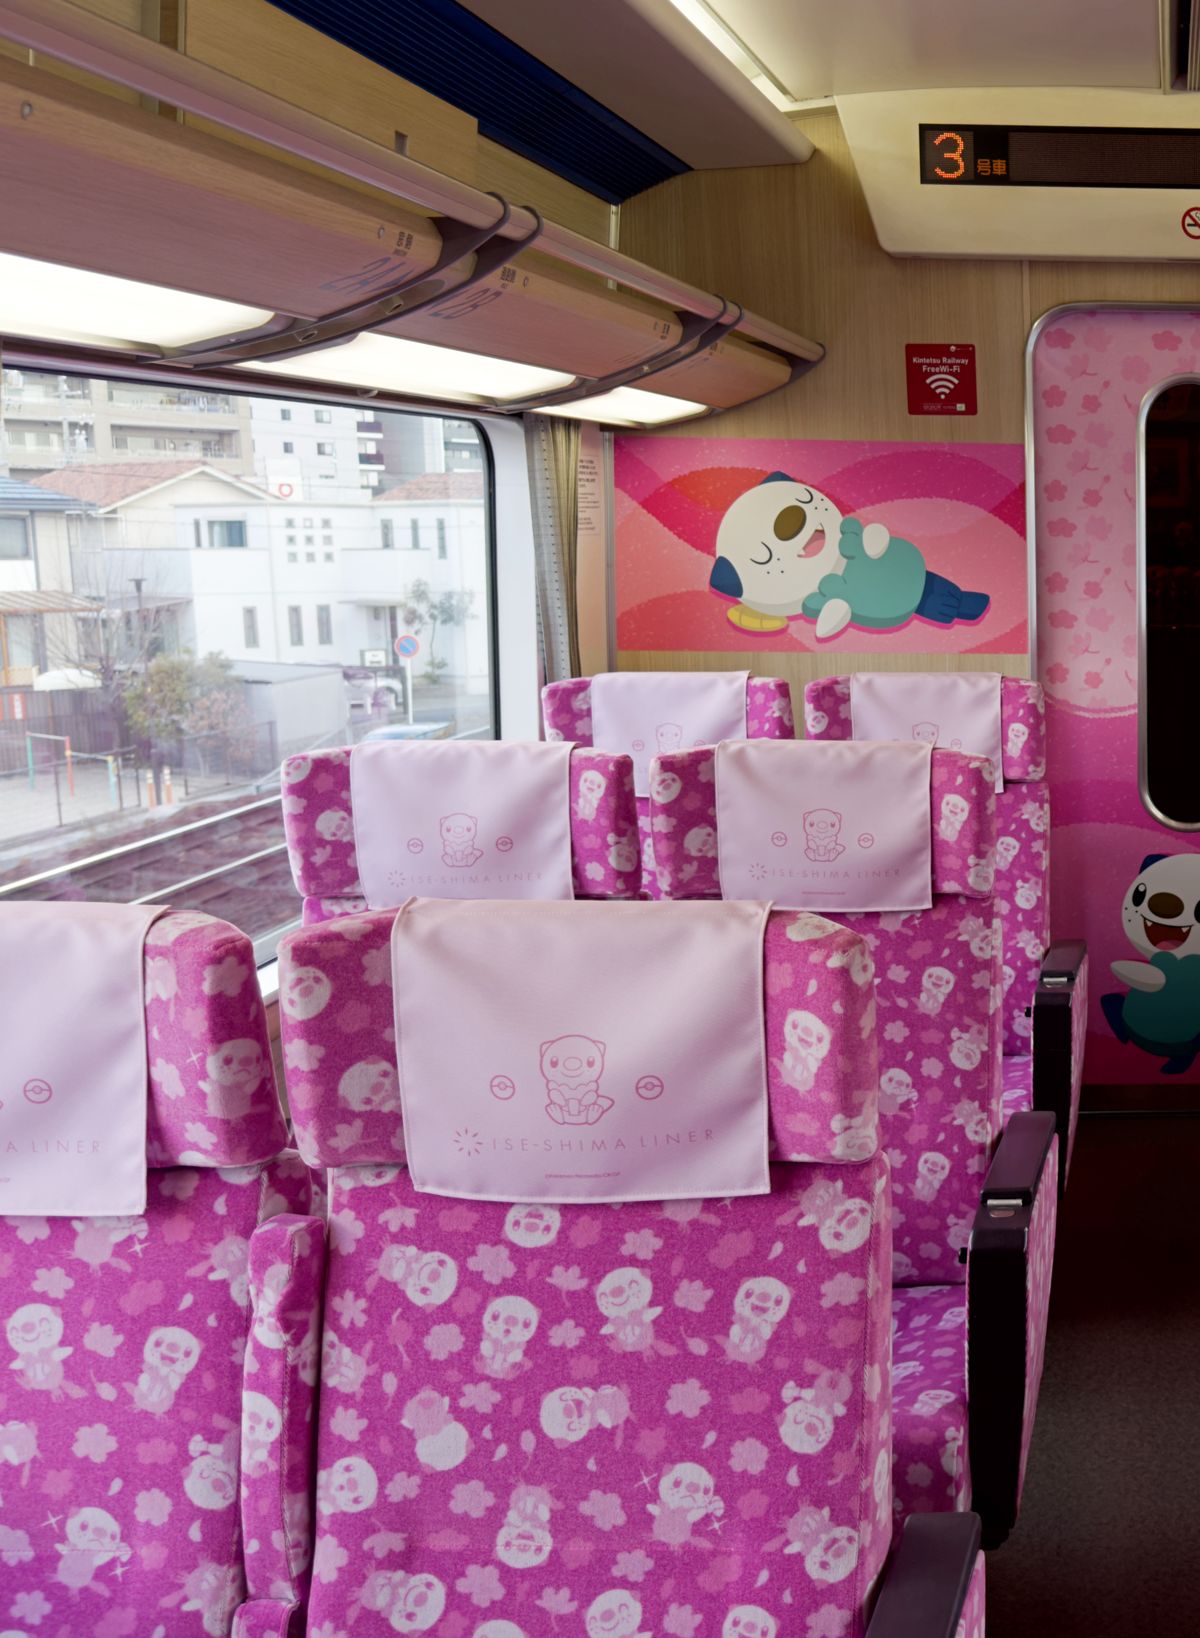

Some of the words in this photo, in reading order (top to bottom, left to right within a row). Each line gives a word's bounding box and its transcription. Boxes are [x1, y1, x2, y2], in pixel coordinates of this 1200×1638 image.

[933, 132, 965, 179] 3
[976, 158, 1007, 176] 号車
[912, 356, 941, 364] Kintetsu
[942, 356, 969, 366] Railway
[31, 1139, 101, 1154] LINER
[492, 1137, 627, 1152] ISE-SHIMA
[640, 1128, 714, 1148] LINER
